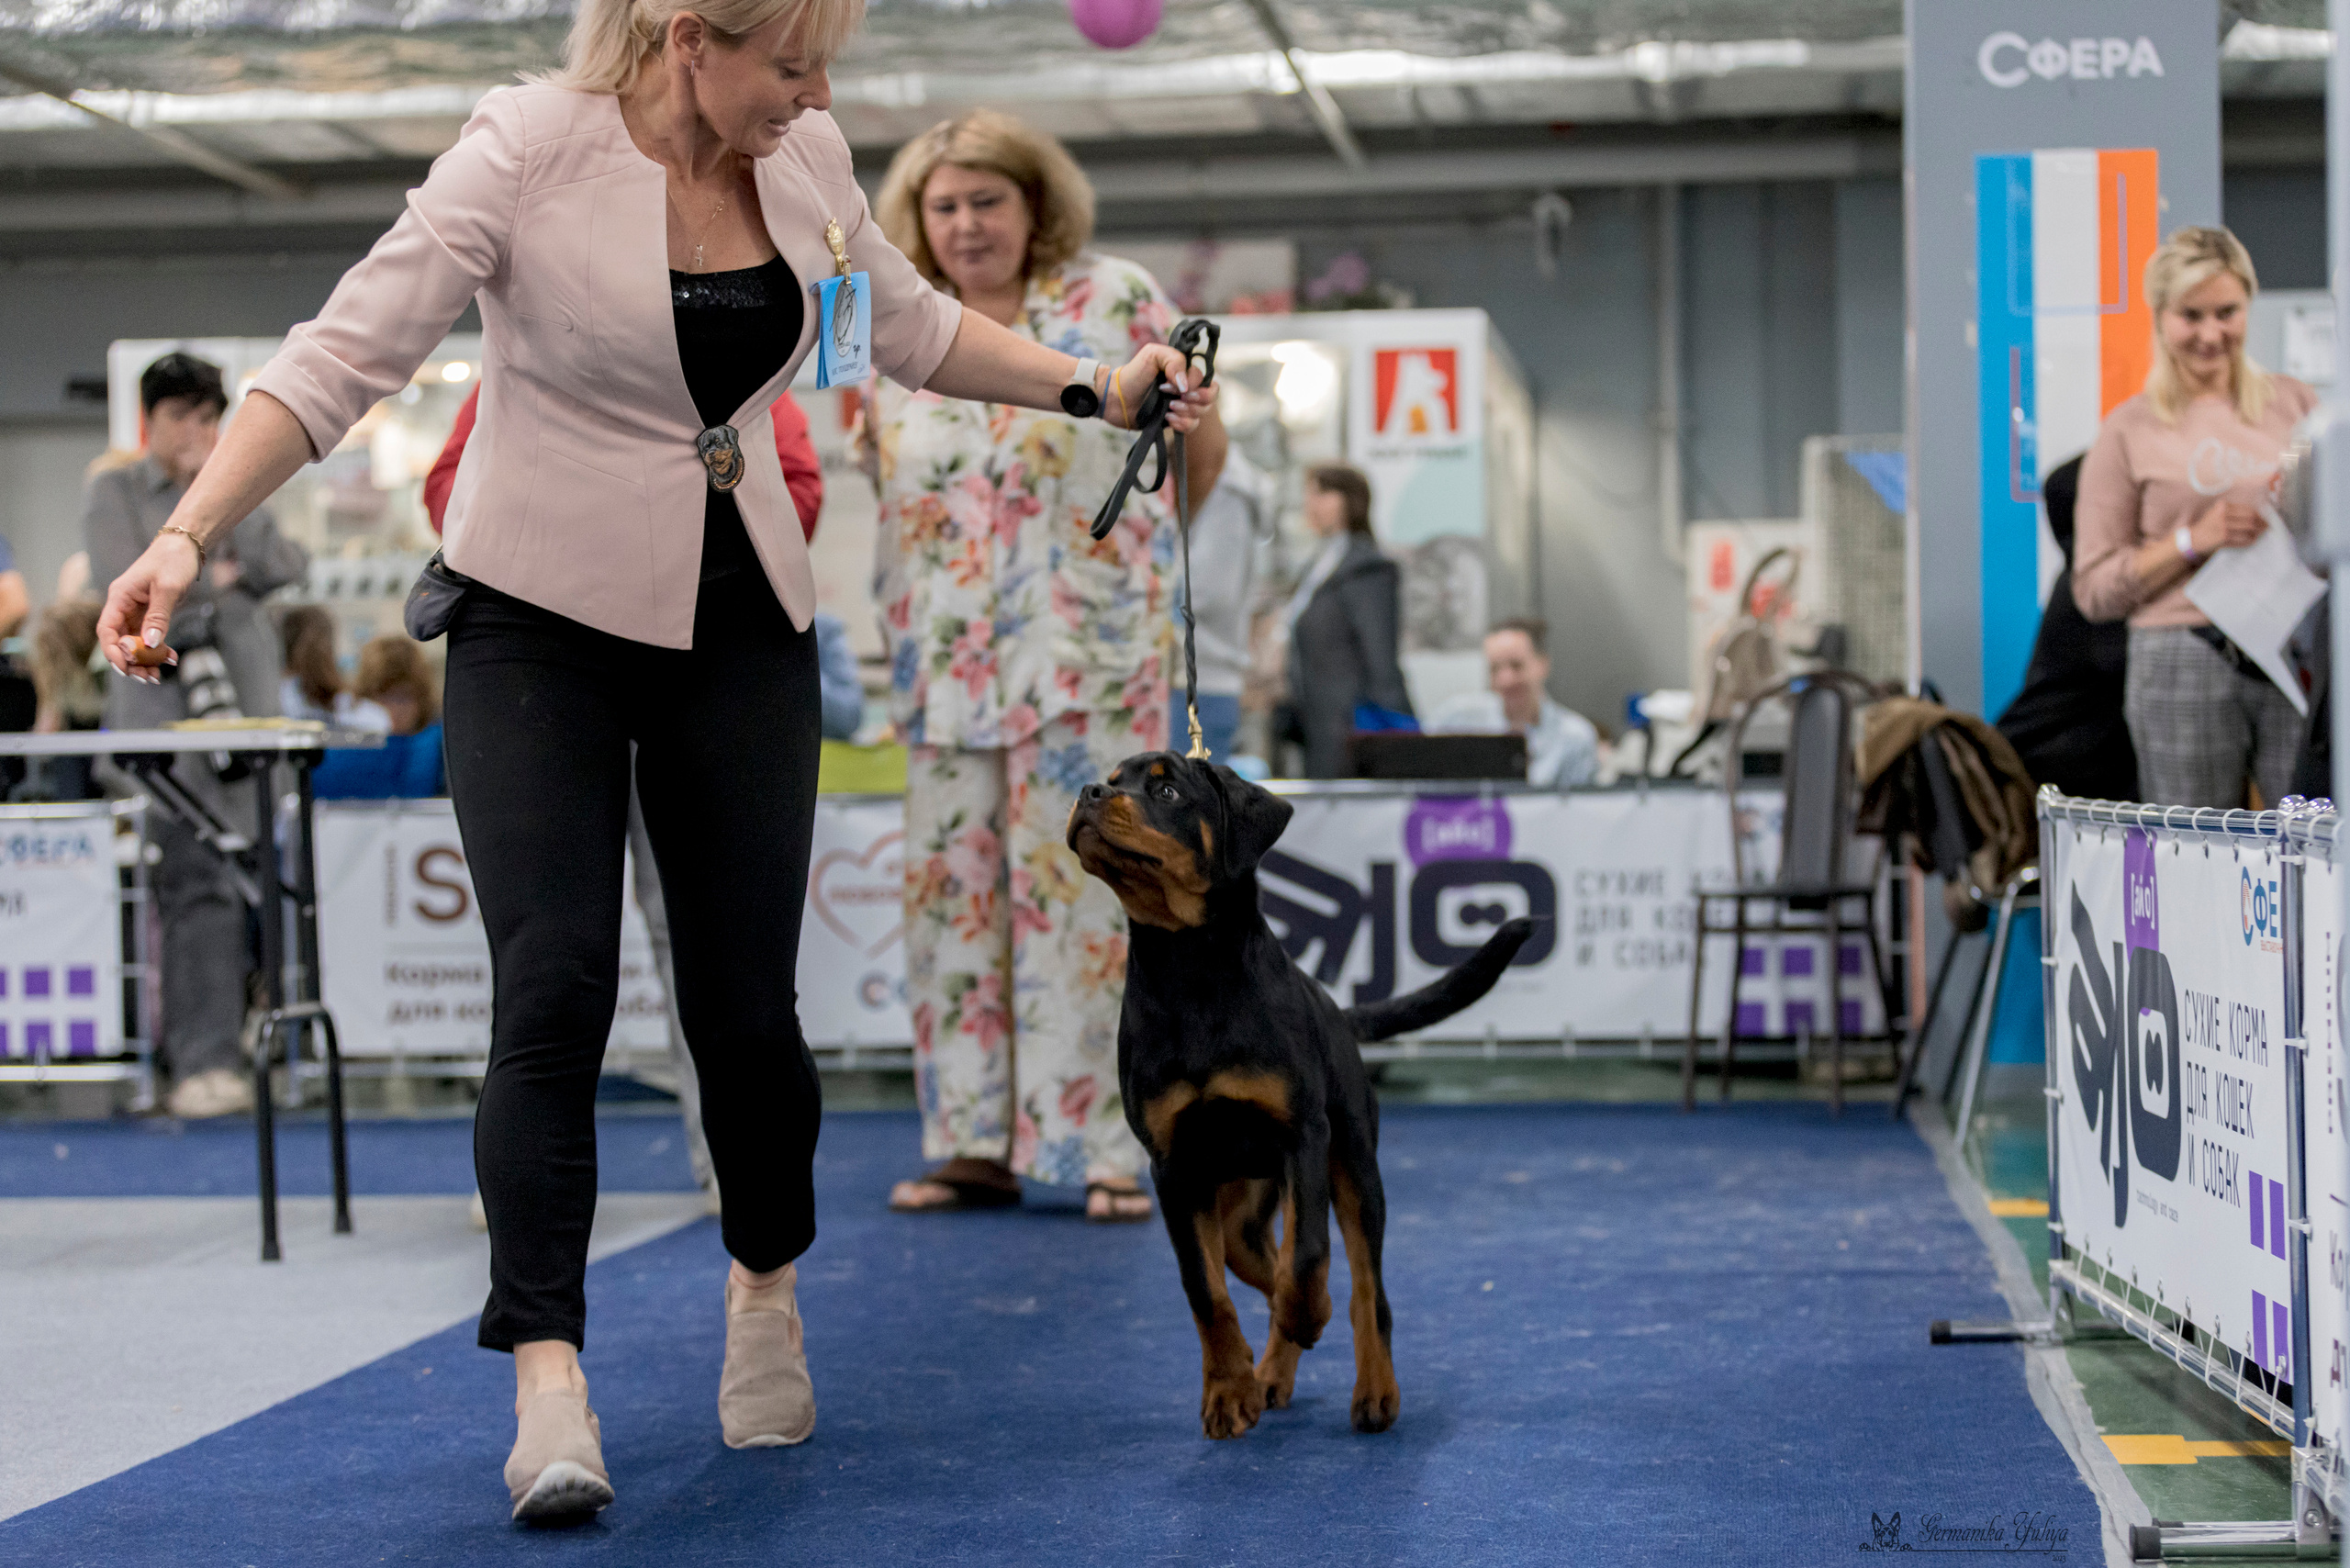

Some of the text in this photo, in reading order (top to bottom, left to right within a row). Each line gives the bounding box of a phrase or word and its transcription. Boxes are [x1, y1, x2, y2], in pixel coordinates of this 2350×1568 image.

[1977, 30, 2165, 88] СФЕРА
[2241, 866, 2282, 946] СФЕ
[1615, 938, 1691, 969] СОБА
[2186, 989, 2267, 1068] СУХИЕ КОРМА
[2187, 1060, 2254, 1139] ДЛЯ КОШЕК
[2188, 1132, 2241, 1208] И СОБАК
